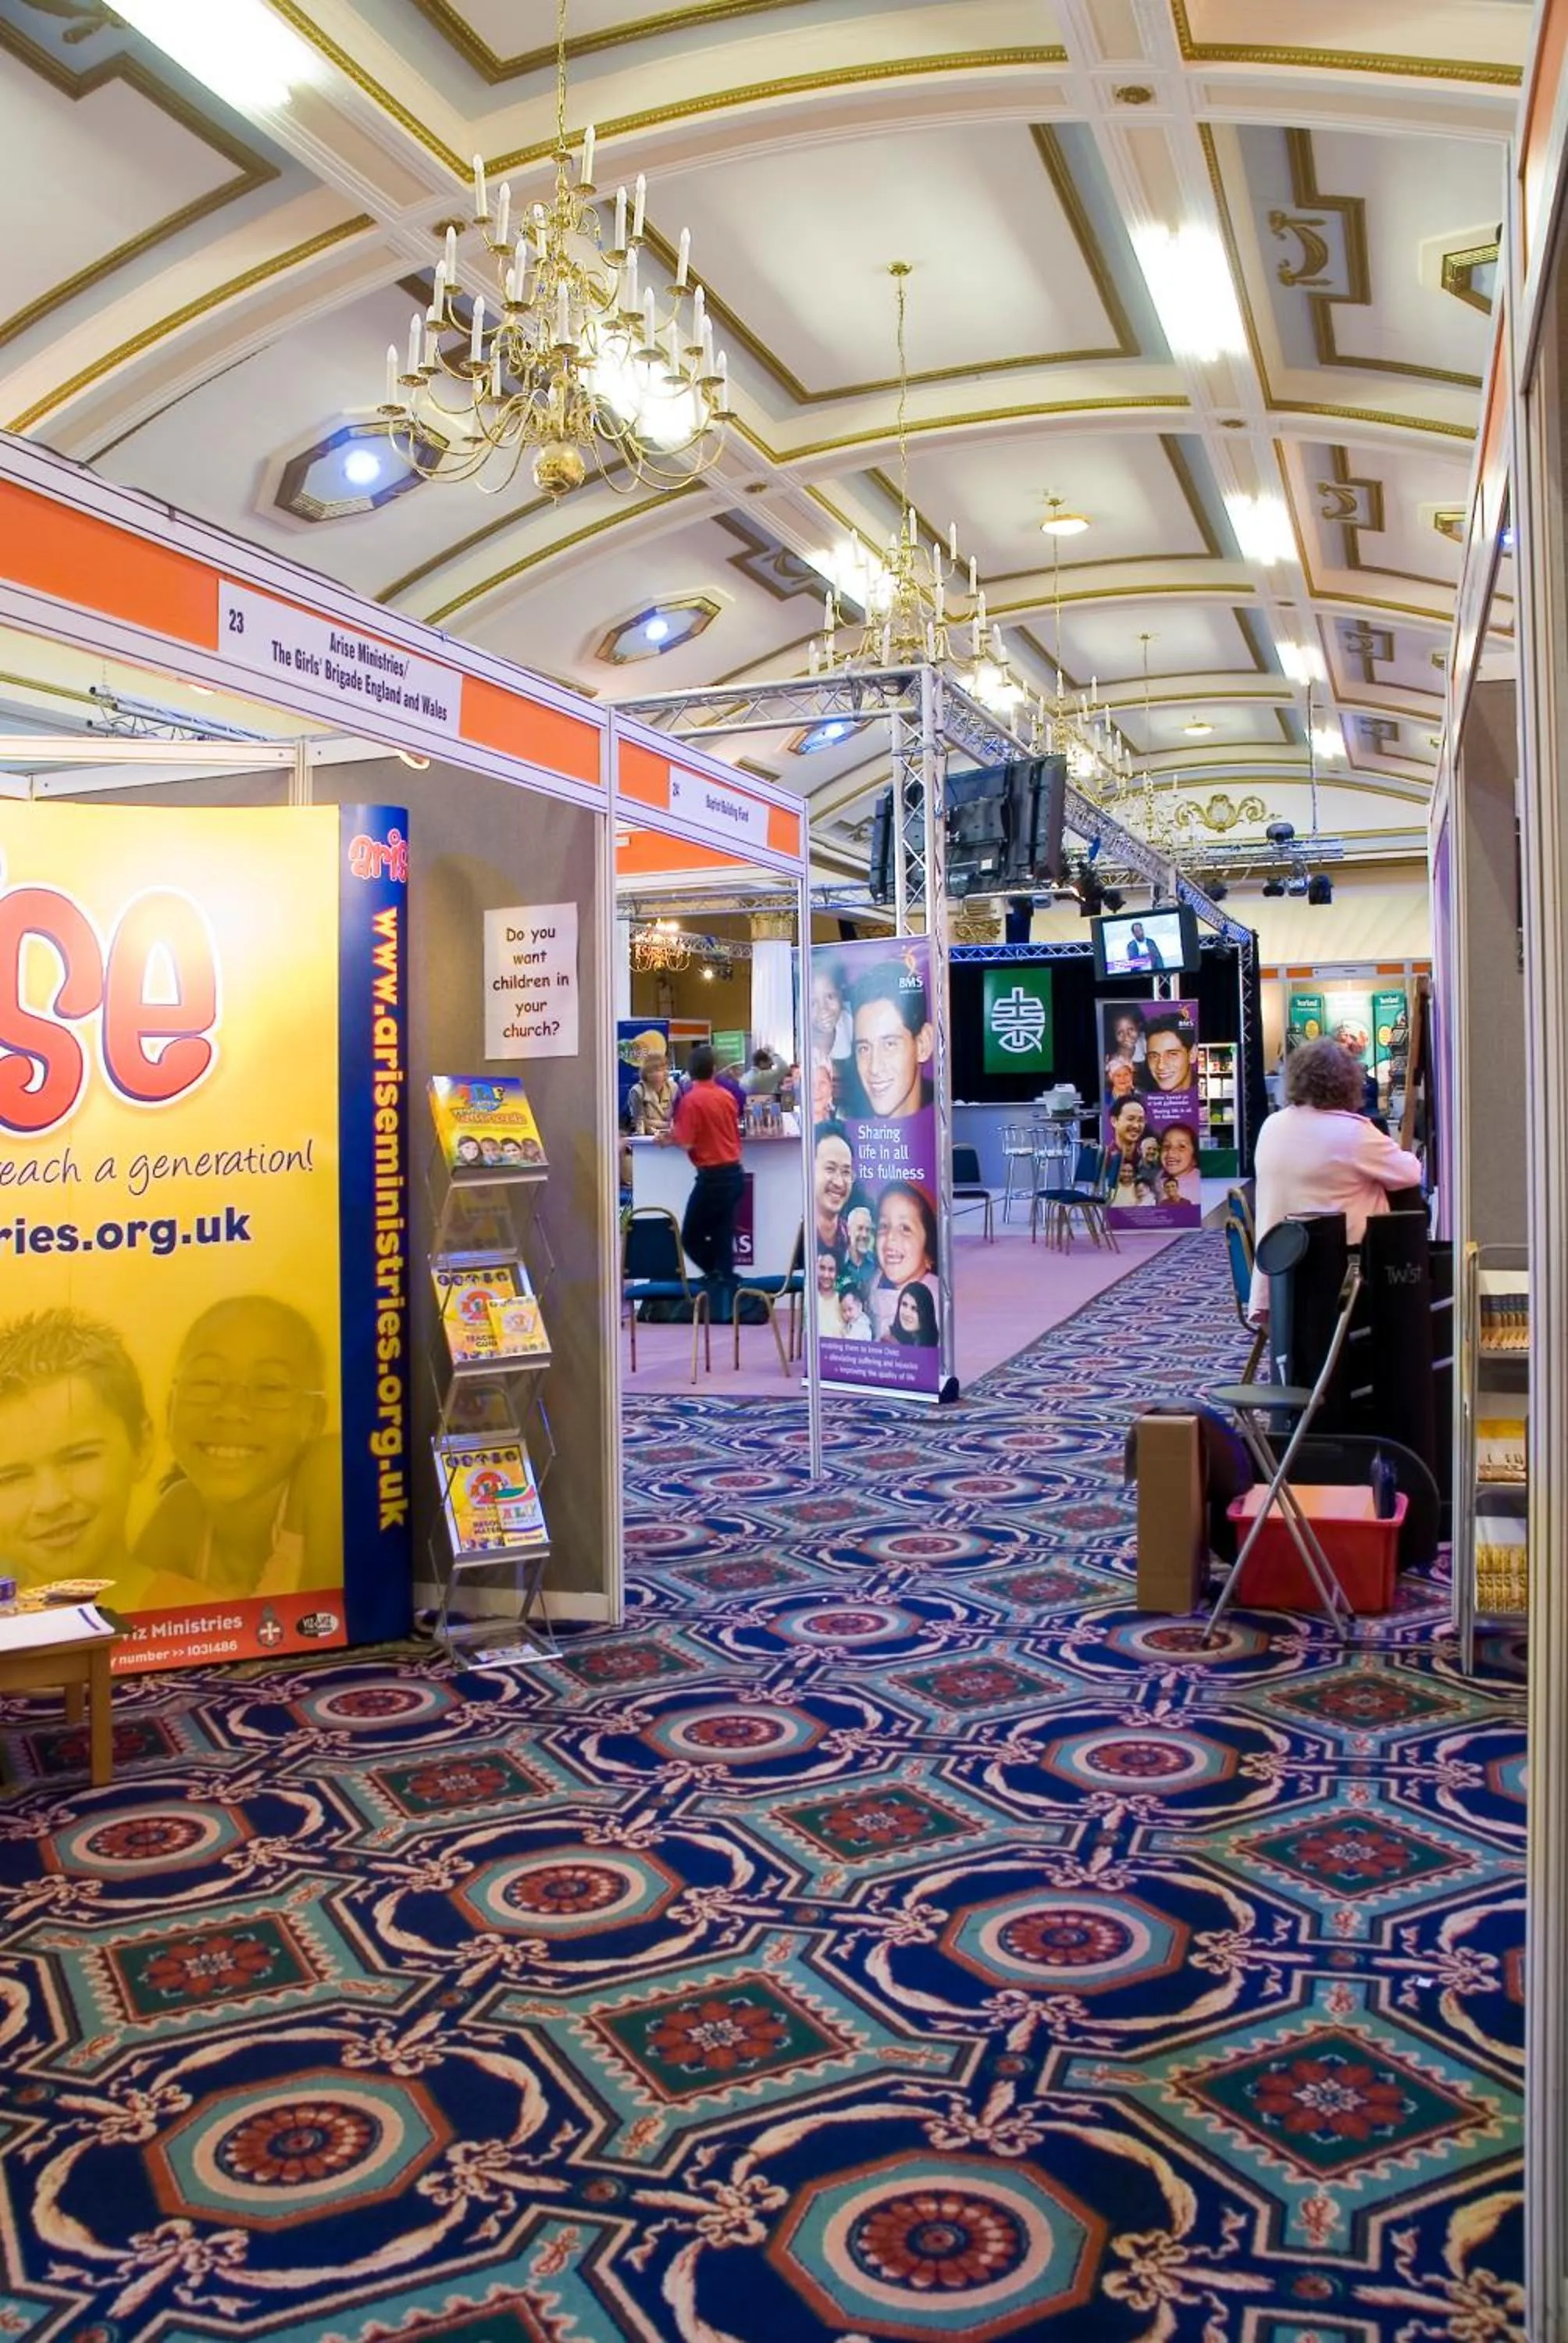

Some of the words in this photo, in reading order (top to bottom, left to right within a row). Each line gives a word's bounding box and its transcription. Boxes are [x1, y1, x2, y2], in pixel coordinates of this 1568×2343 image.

[229, 608, 244, 634] 23
[330, 632, 355, 659] Arise
[272, 640, 291, 666] The
[294, 650, 323, 676] Girls'
[325, 659, 363, 692] Brigade
[365, 674, 402, 704] England
[404, 693, 419, 711] and
[422, 695, 447, 722] Wales
[506, 927, 525, 942] Do
[531, 927, 556, 944] you
[513, 950, 547, 965] want
[493, 974, 551, 991] children
[557, 972, 569, 986] in
[899, 976, 924, 988] BMS
[515, 1000, 547, 1018] your
[502, 1021, 560, 1039] church?
[858, 1125, 900, 1143] Sharing
[859, 1145, 876, 1160] life
[880, 1145, 889, 1160] in
[893, 1145, 909, 1160] all
[0, 1148, 81, 1186] each
[94, 1156, 117, 1183] a
[128, 1139, 314, 1196] generation!
[860, 1164, 874, 1179] its
[878, 1164, 925, 1180] fullness
[369, 905, 410, 1532] www.ariseministries.org.uk
[151, 1614, 244, 1638] Ministries
[119, 1649, 171, 1665] number
[187, 1640, 238, 1657] 1031486
